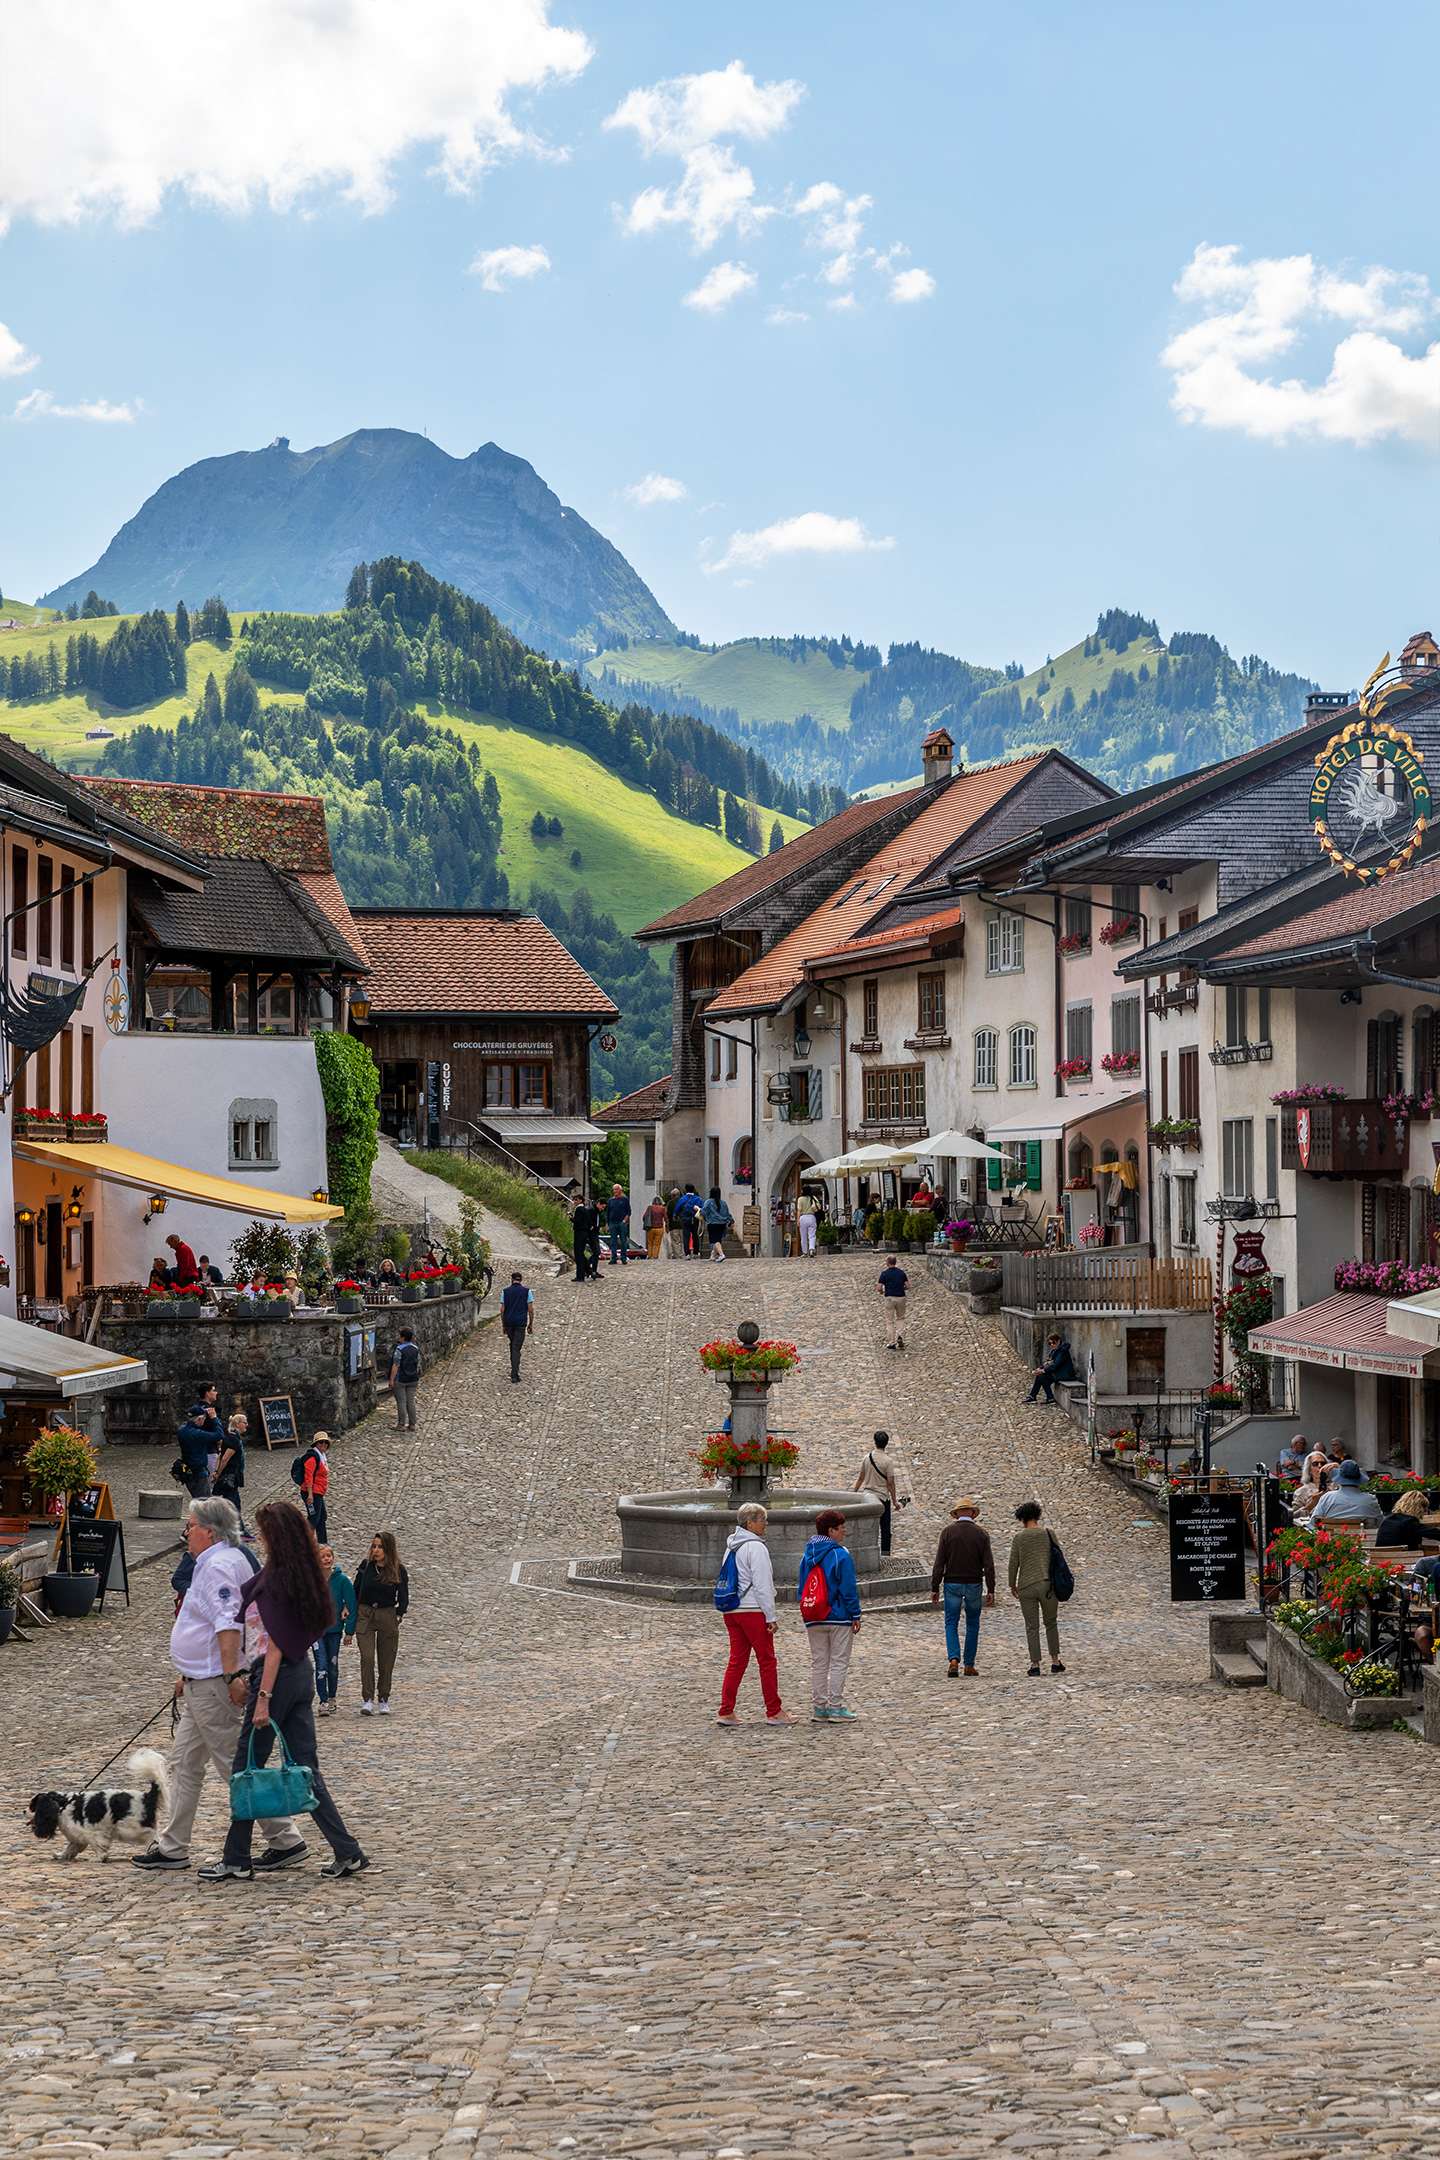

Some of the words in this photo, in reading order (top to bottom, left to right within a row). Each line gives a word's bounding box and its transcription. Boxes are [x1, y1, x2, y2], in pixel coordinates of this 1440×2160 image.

[1311, 748, 1356, 804] HOTEL
[1358, 739, 1390, 756] DE
[1392, 748, 1430, 800] VILLE
[517, 1041, 554, 1049] GRUYÈRES
[443, 1063, 451, 1111] OUVERT
[1262, 1339, 1273, 1351] Café
[1276, 1343, 1298, 1356] restaurant
[1299, 1345, 1307, 1357] des
[1307, 1346, 1329, 1361] Remparts
